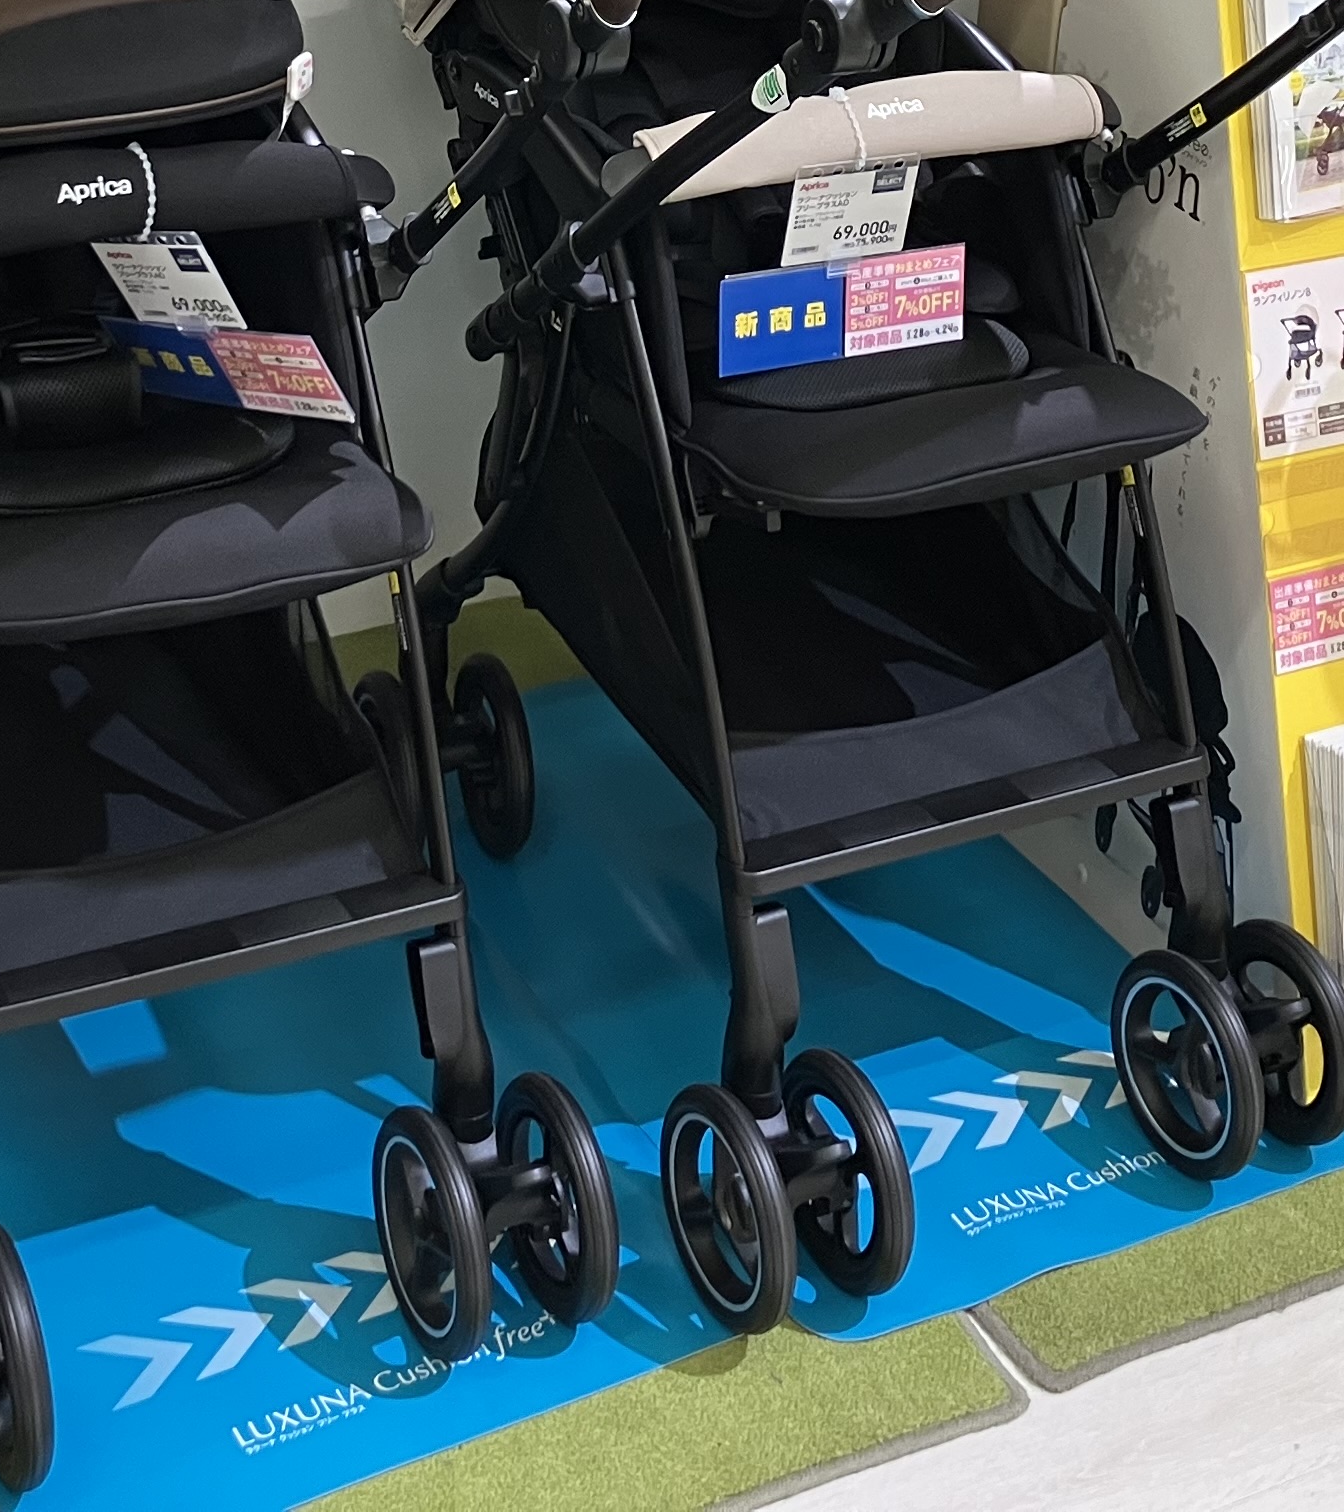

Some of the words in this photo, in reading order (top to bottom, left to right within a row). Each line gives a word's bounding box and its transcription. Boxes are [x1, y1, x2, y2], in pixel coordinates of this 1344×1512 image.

[867, 96, 924, 119] Aprica
[56, 176, 133, 205] Aprica
[799, 180, 830, 192] Aprica
[832, 220, 898, 241] 69,000円
[895, 290, 960, 319] 7%OFF!
[951, 1181, 1069, 1231] LUXUNA
[1066, 1150, 1166, 1191] Cushion
[232, 1382, 372, 1448] LUXUNA
